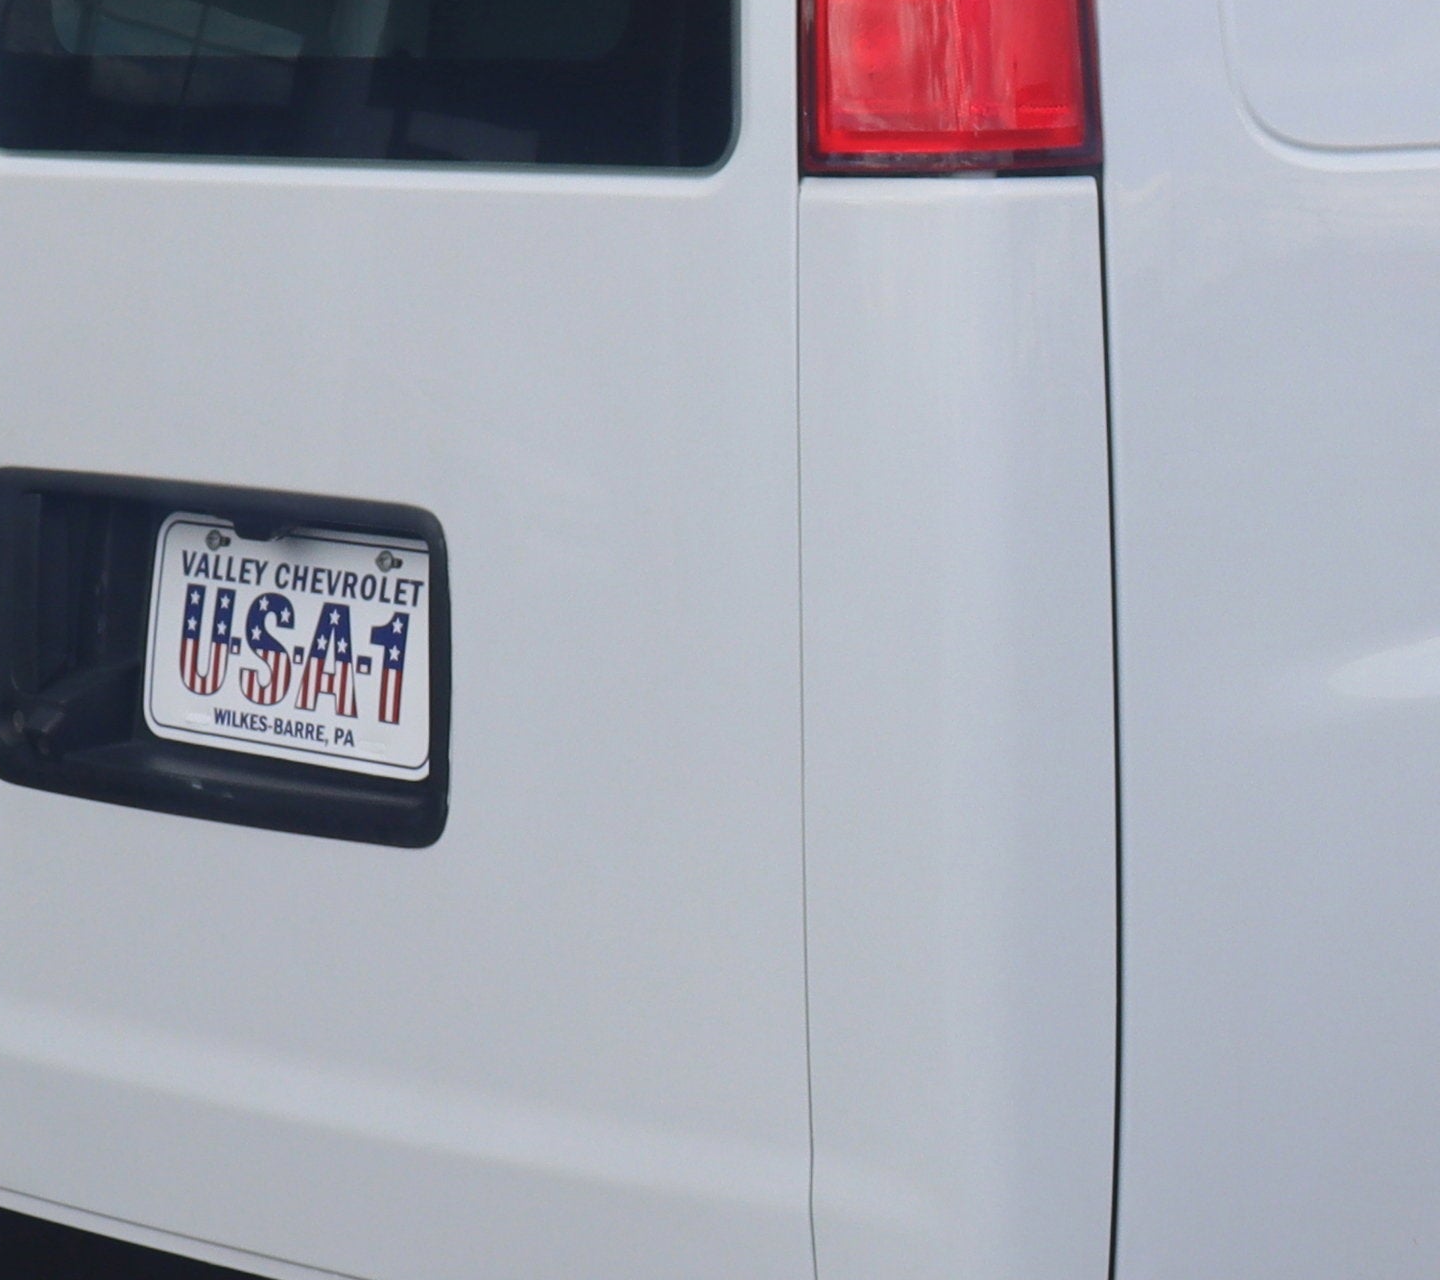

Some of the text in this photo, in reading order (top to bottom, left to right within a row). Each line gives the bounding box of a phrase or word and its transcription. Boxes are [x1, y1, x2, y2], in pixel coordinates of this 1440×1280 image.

[181, 550, 424, 608] VALLEY CHEVROLET
[213, 707, 355, 748] WILKES-BARRE, PA
